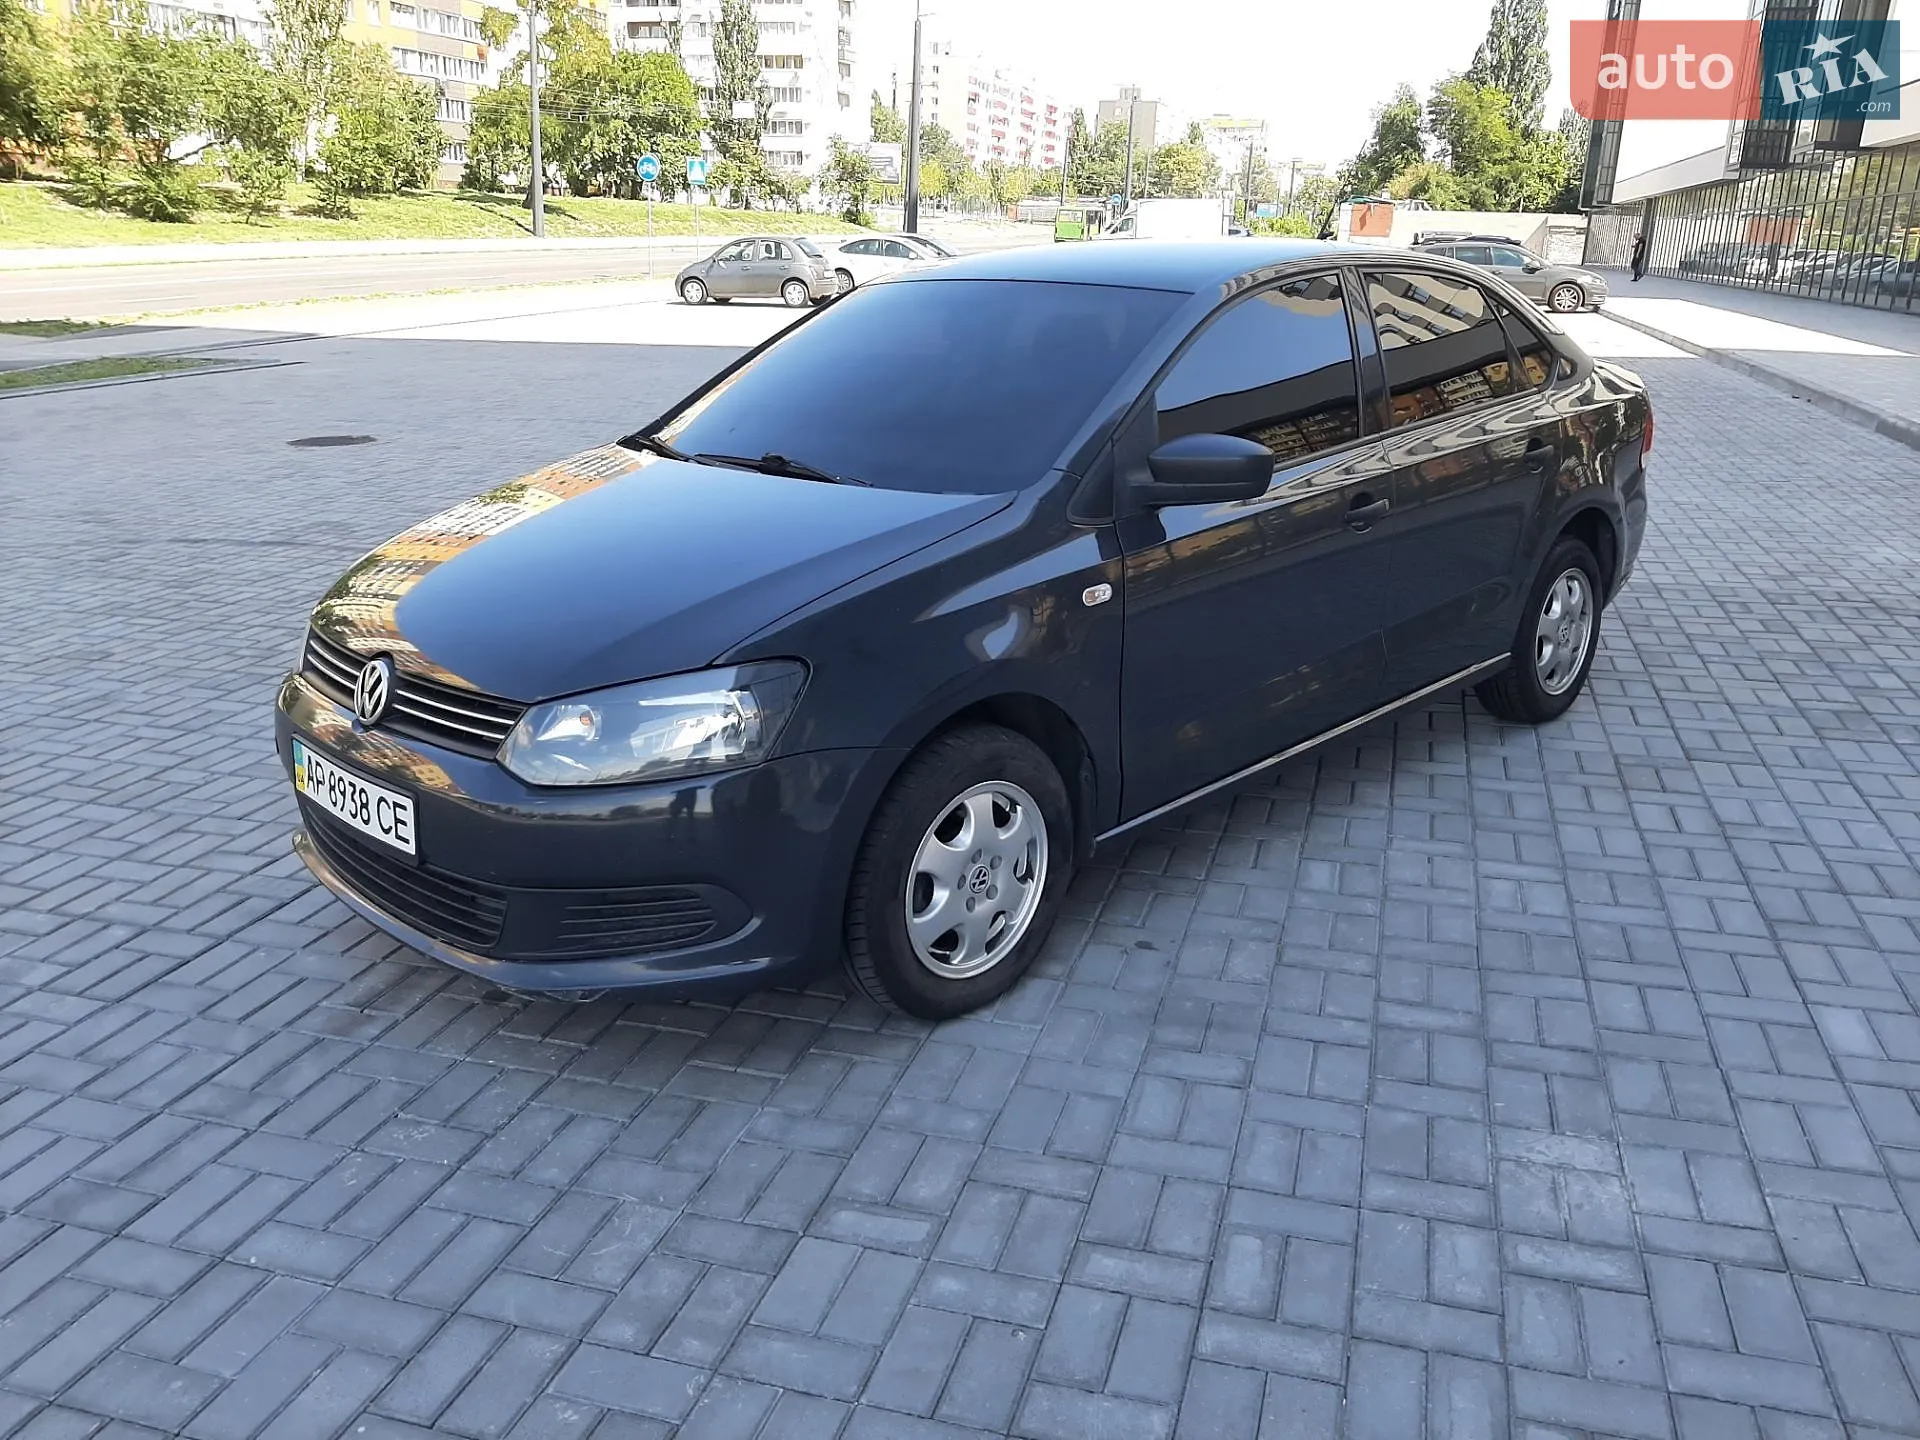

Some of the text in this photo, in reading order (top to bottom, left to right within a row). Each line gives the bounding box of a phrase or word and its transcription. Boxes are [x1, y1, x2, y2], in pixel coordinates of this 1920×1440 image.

[307, 754, 411, 845] AP 8938 CE
